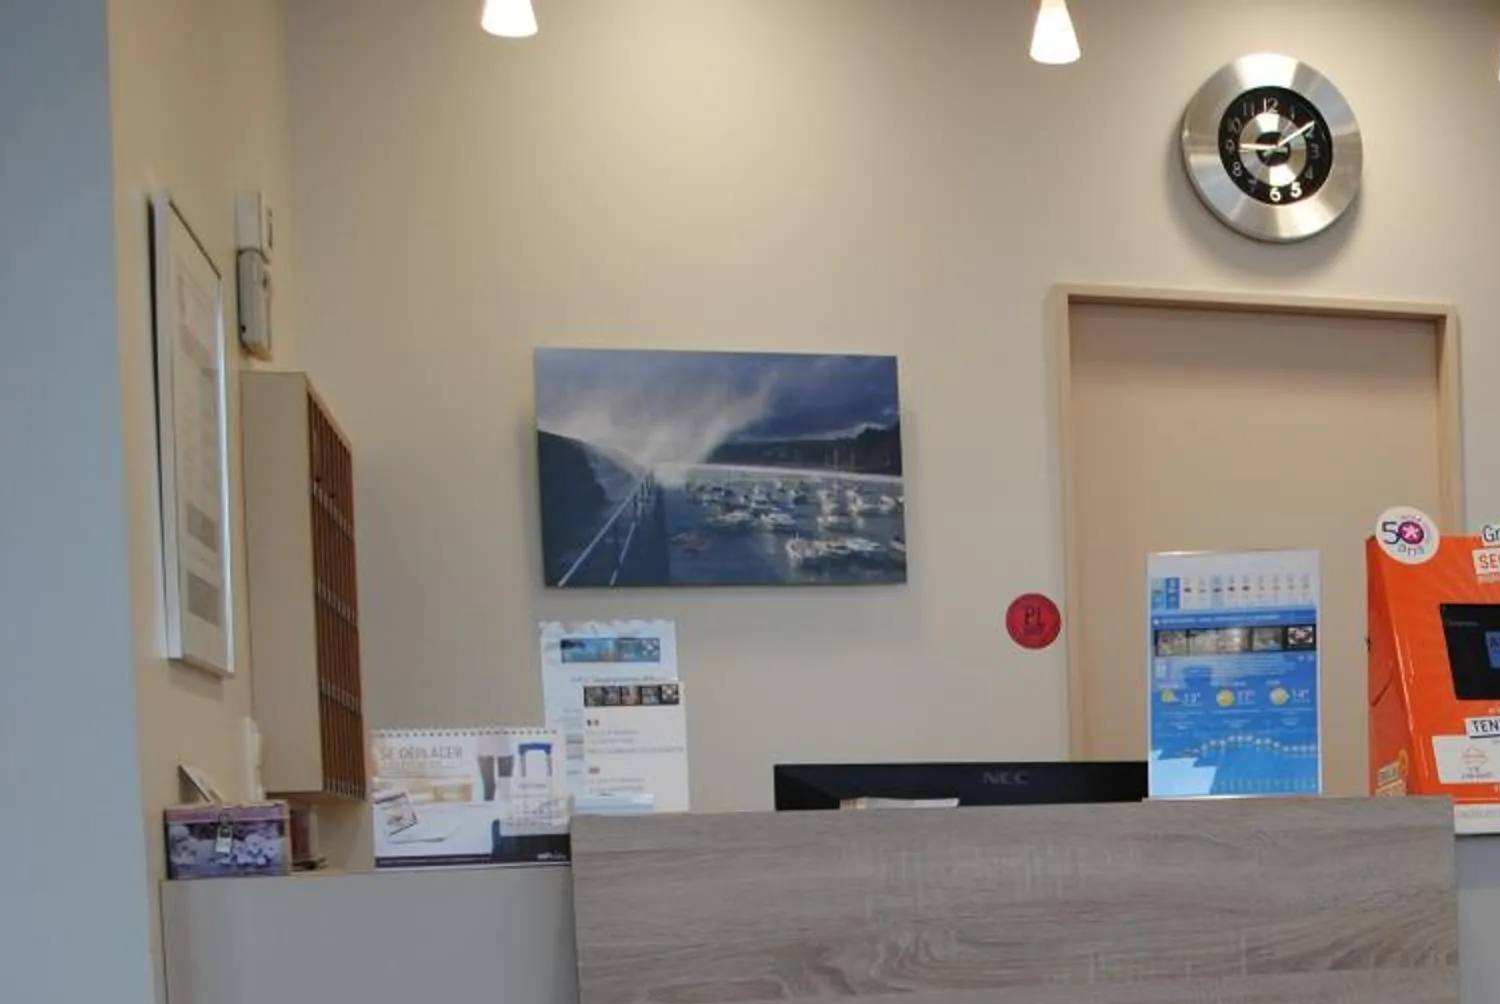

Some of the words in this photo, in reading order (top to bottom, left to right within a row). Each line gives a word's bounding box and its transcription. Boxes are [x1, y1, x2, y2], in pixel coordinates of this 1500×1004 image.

[1263, 97, 1279, 113] 12
[1225, 139, 1235, 154] 9
[1311, 143, 1321, 159] 3
[1232, 161, 1243, 177] 8
[1269, 186, 1281, 202] 6
[1290, 181, 1303, 198] 5
[983, 770, 1030, 785] NEC
